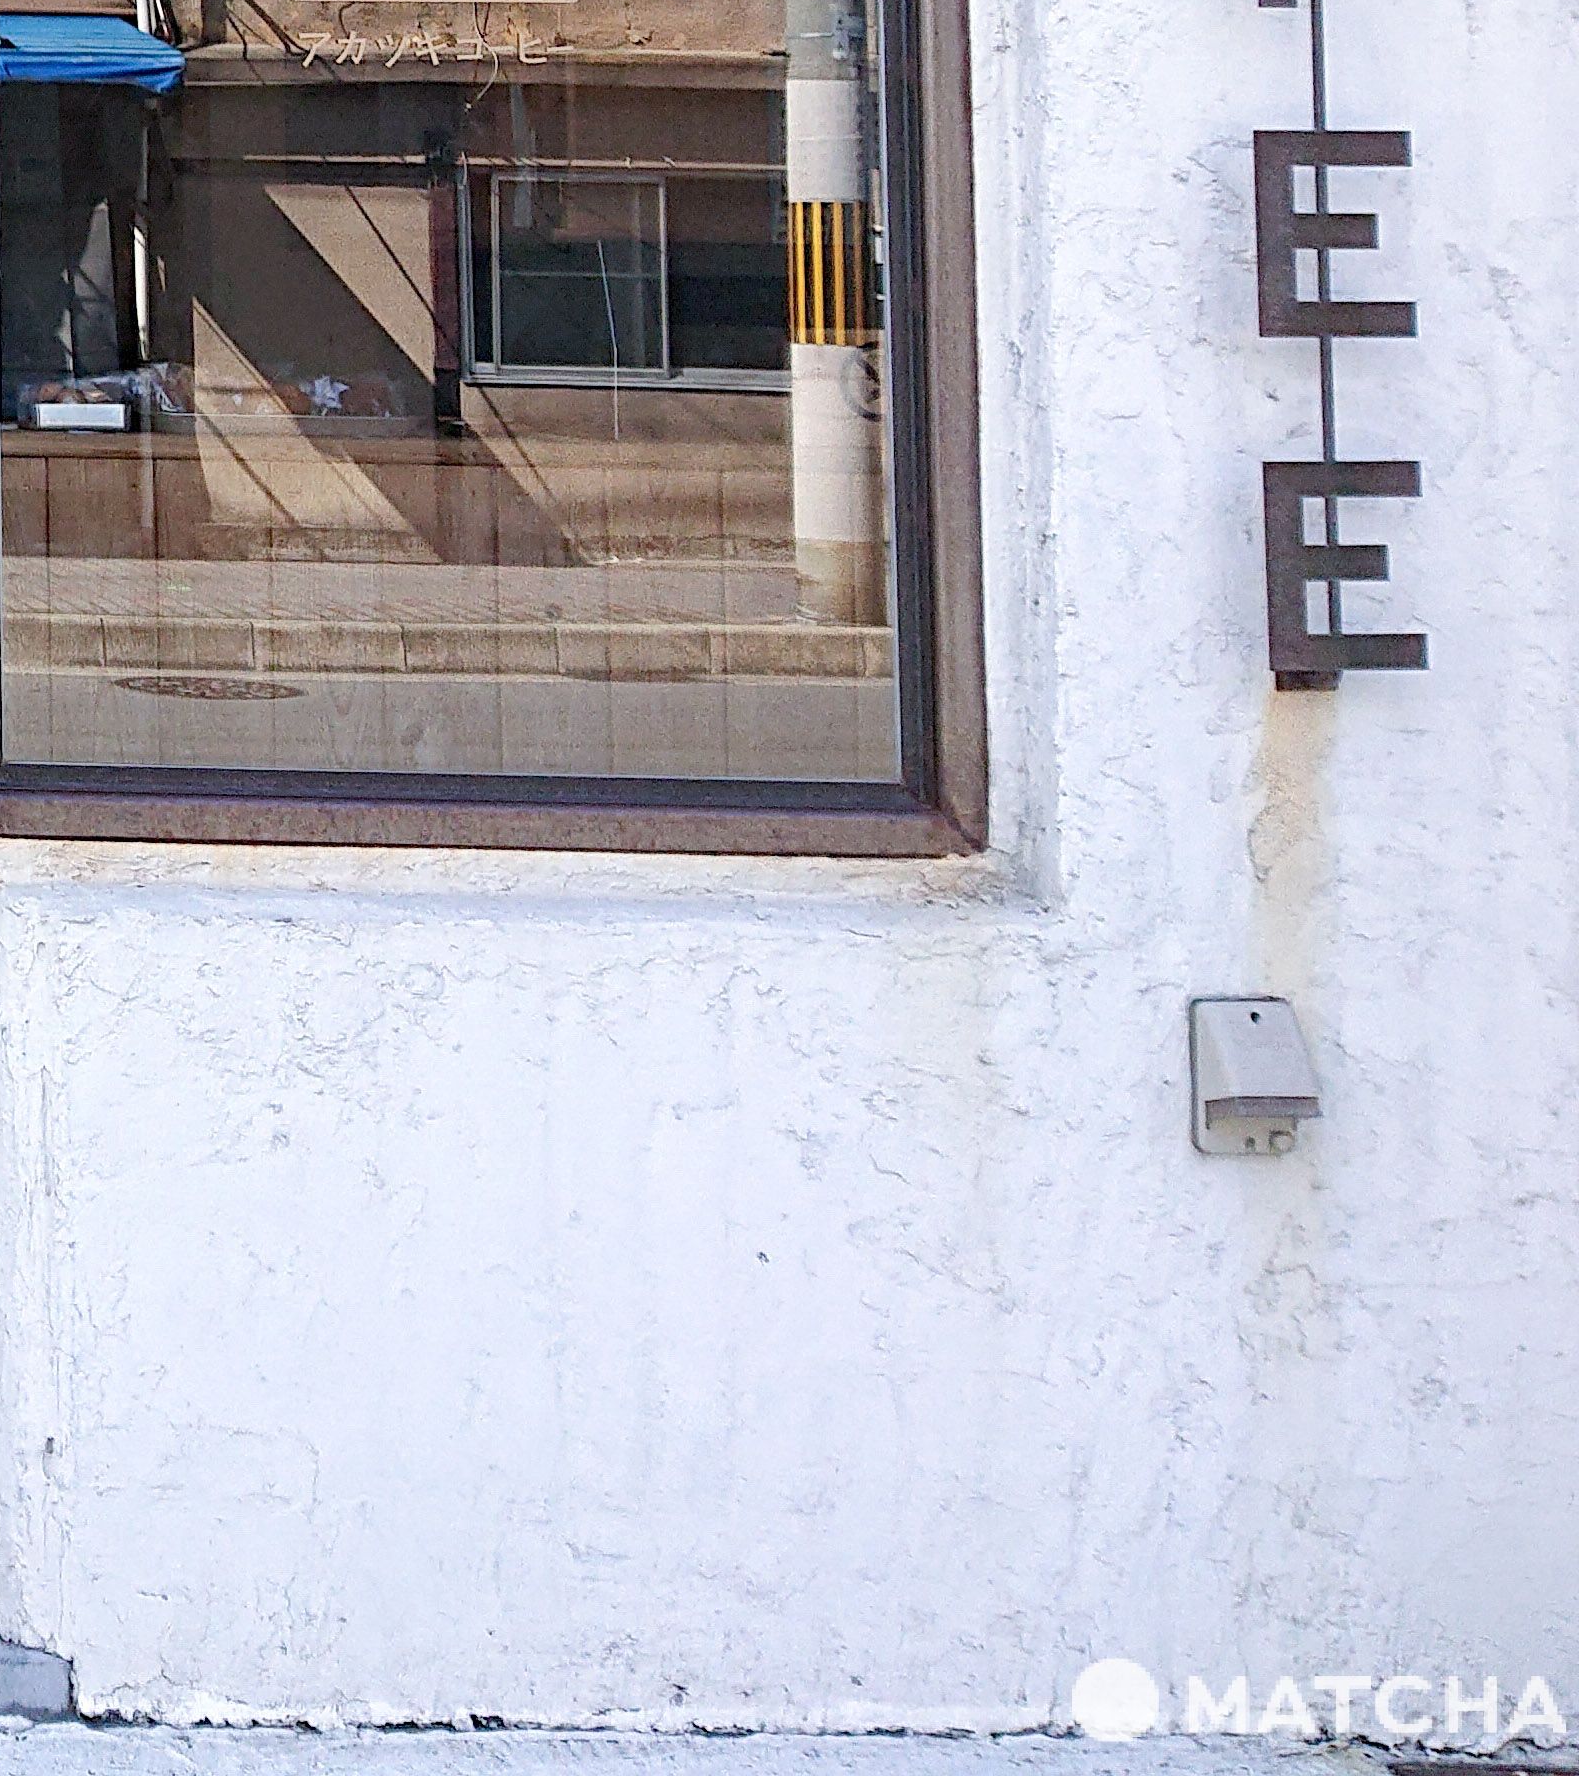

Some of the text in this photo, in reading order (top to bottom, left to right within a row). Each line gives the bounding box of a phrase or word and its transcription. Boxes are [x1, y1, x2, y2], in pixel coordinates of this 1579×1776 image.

[298, 29, 575, 69] アカツキコーヒー
